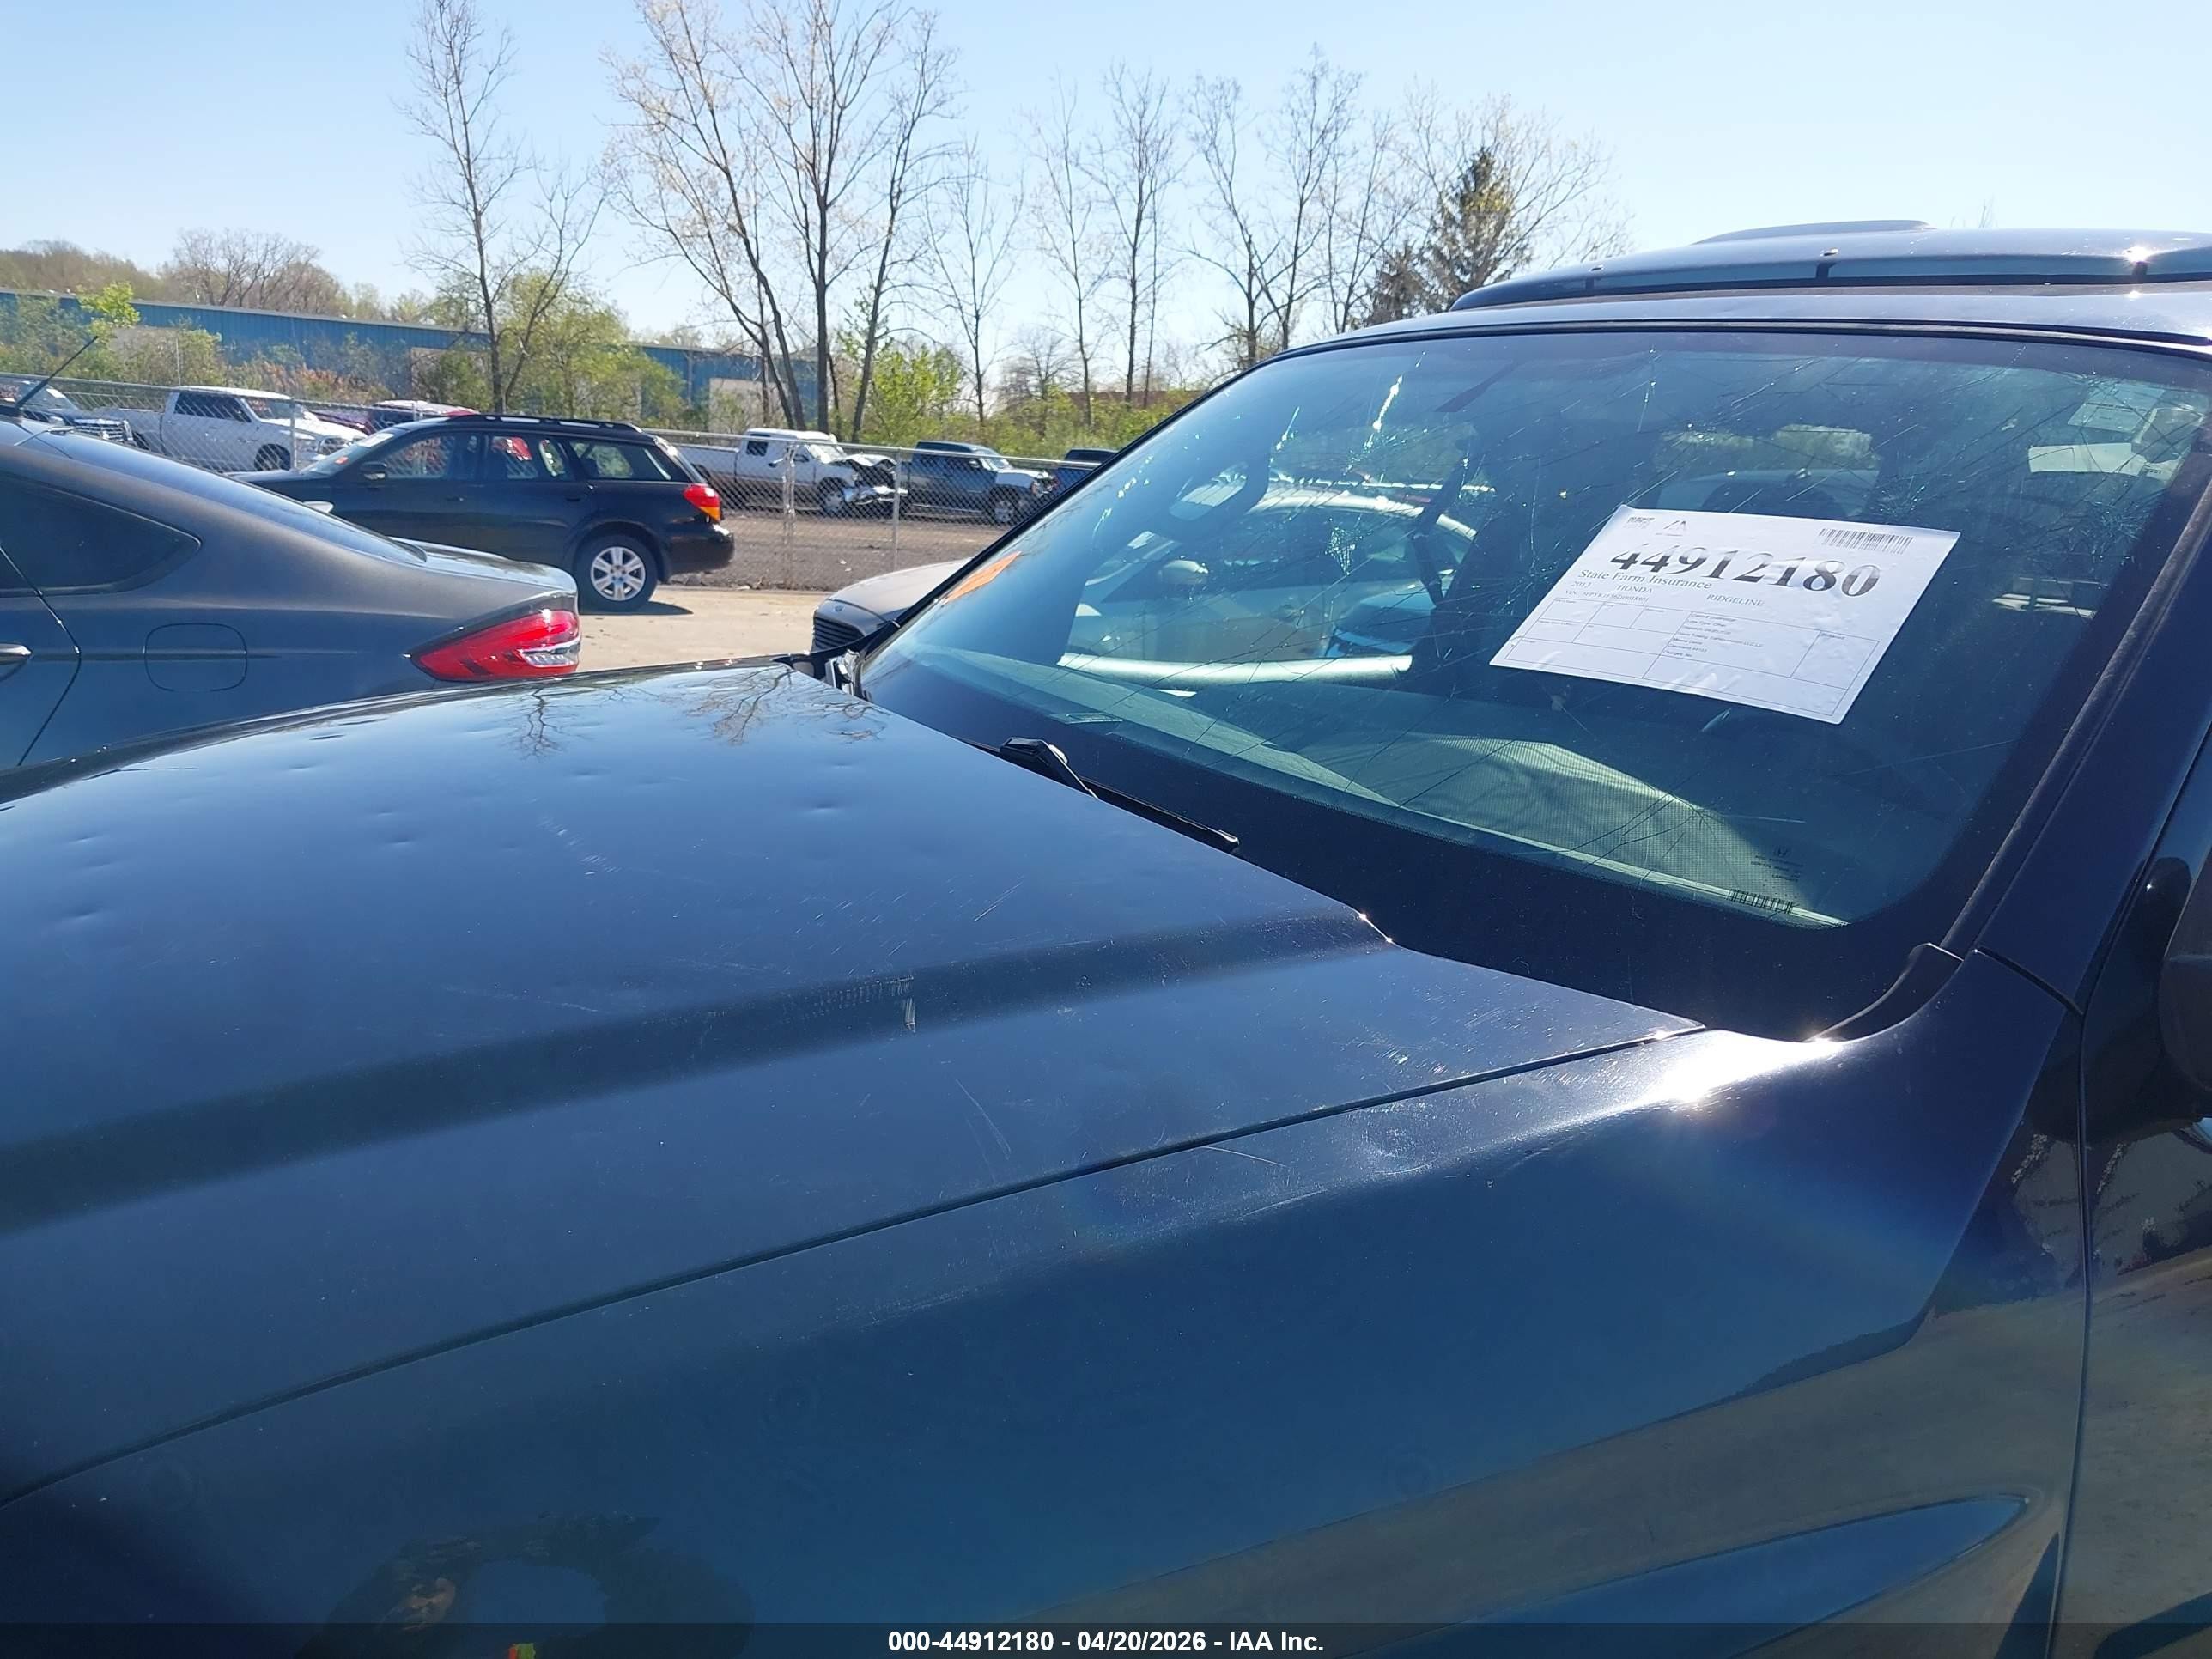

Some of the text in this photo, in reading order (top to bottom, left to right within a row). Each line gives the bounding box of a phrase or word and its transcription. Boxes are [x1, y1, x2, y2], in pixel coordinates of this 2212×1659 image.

[1578, 569, 1712, 589] State Farm Insurance
[1610, 543, 1881, 597] 44912180
[1616, 584, 1654, 594] HONDA
